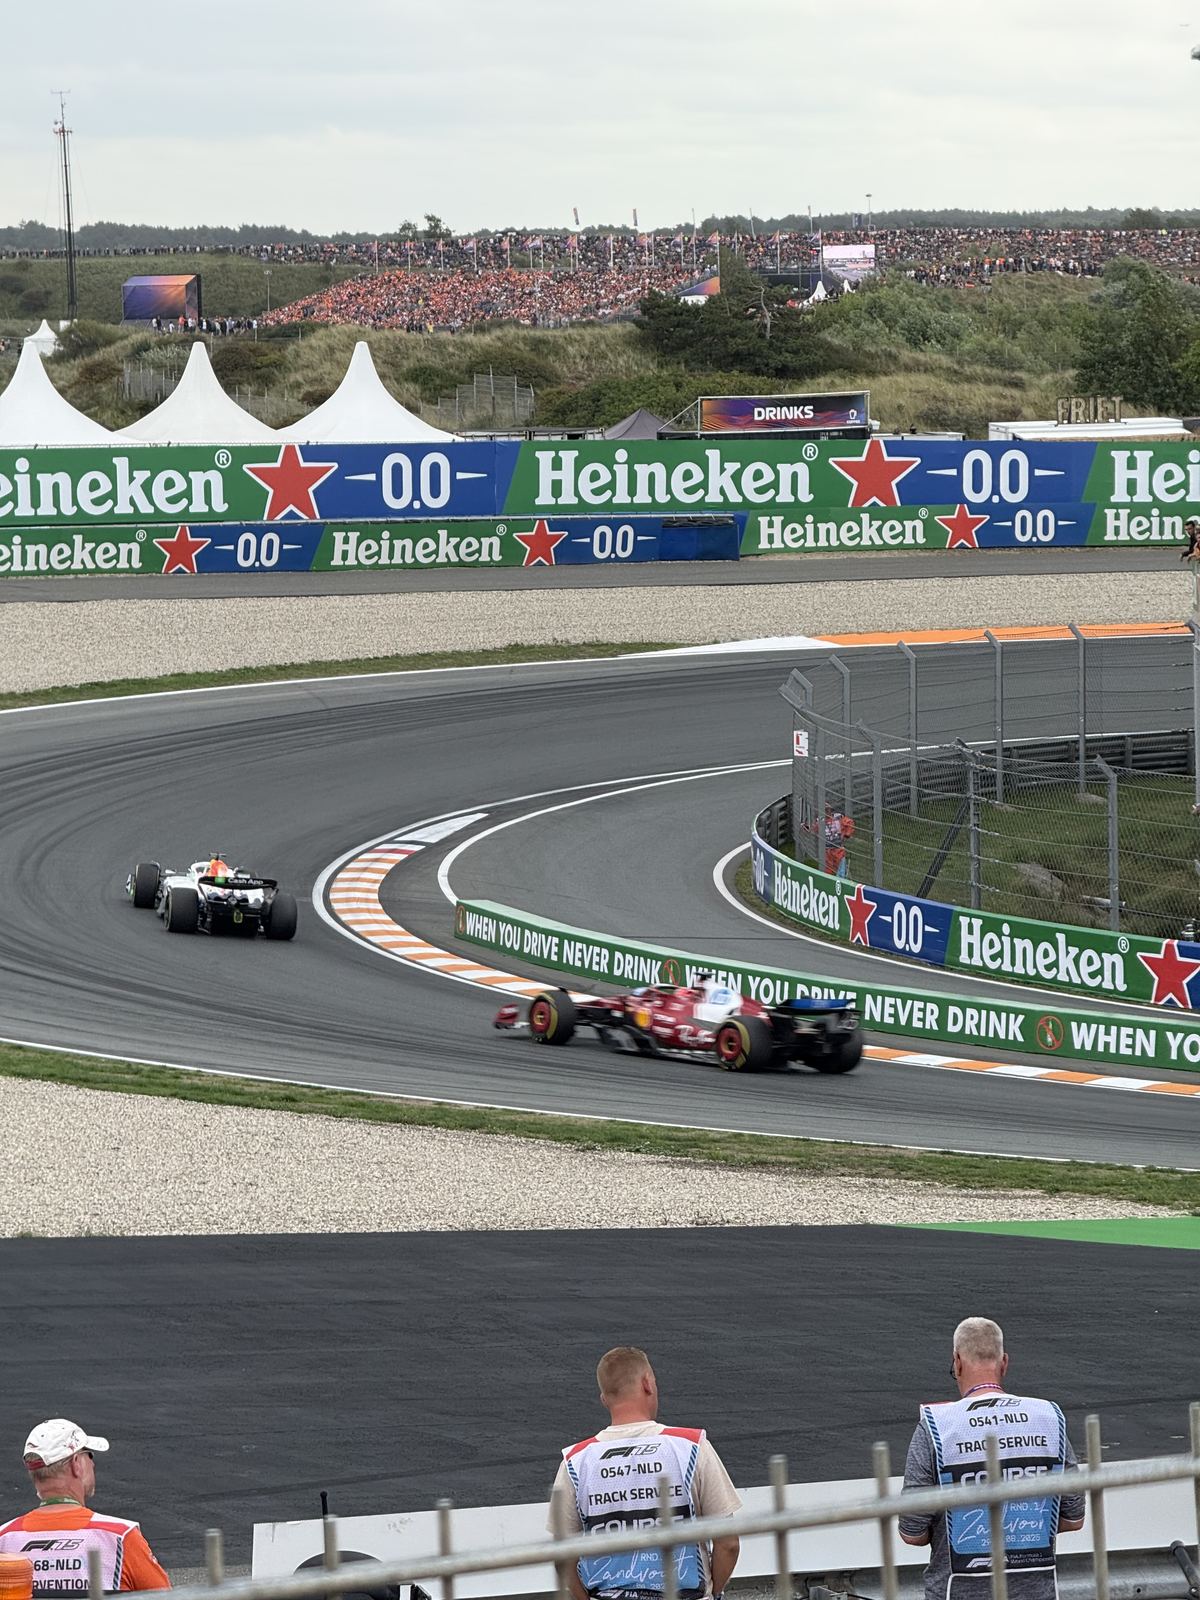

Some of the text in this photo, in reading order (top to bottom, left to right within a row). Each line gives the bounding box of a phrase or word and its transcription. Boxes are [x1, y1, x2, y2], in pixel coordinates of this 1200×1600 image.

[753, 405, 814, 421] DRINKS
[1057, 396, 1124, 423] FRIET
[466, 911, 662, 985] WHEN YOU DRIVE NEVER DRINK
[748, 975, 789, 1005] YOU
[864, 993, 939, 1031] NEVER
[947, 1005, 1025, 1042] DRINK
[1070, 1021, 1156, 1057] WHEN
[969, 1412, 1028, 1428] 0541-NLD
[956, 1435, 1048, 1454] TRAC SERVICE
[600, 1462, 663, 1479] 0547-NLD
[588, 1485, 683, 1506] TRACK SERVCE
[33, 1558, 82, 1571] 68-NLD
